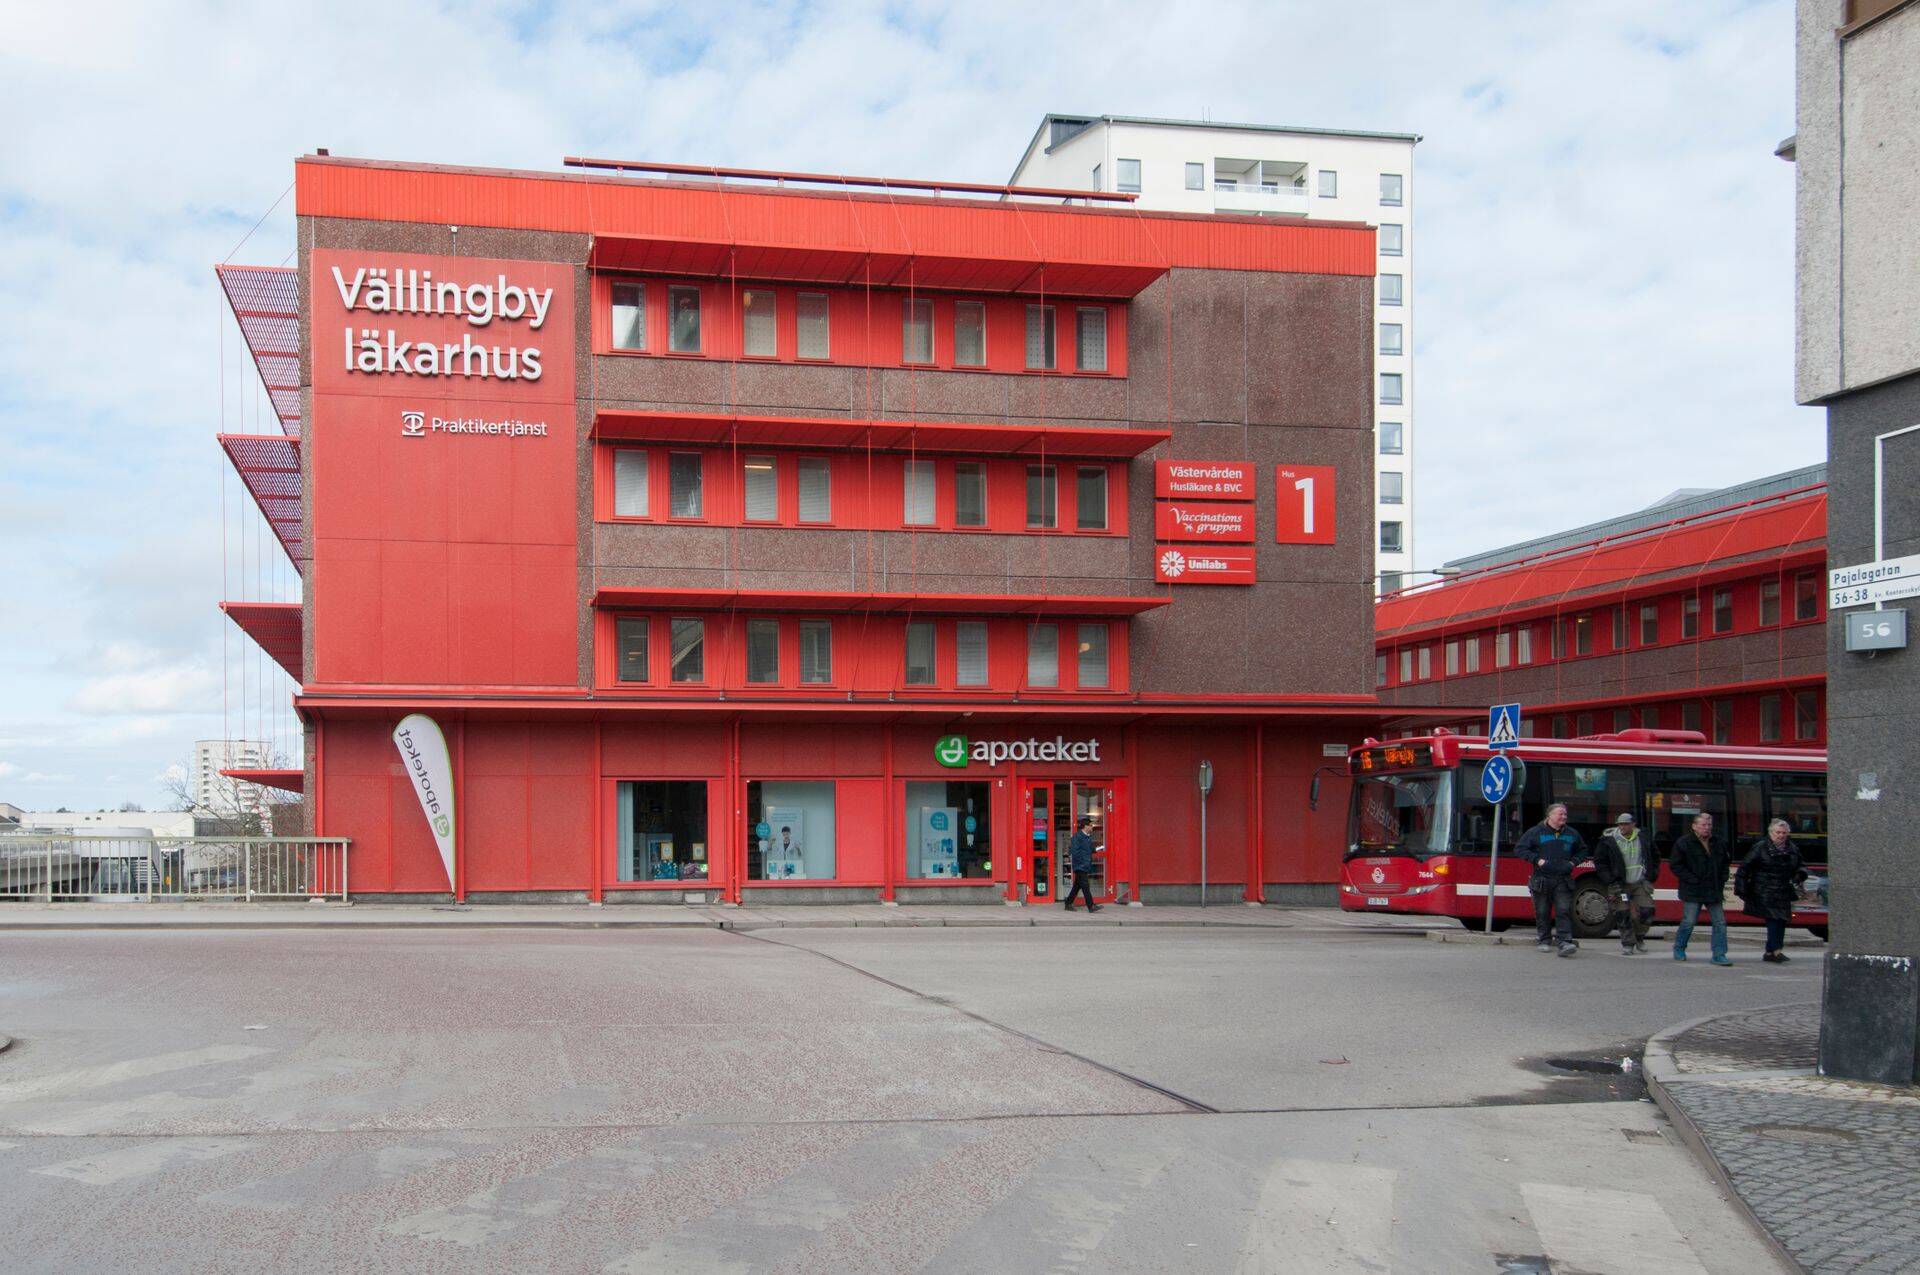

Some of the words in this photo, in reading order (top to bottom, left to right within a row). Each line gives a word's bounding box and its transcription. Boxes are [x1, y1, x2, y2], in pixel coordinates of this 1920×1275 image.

[332, 266, 553, 329] Vällingby
[345, 327, 542, 380] läkarhus
[432, 417, 547, 437] Praktikertjänst
[1170, 466, 1243, 478] Västervården
[1281, 470, 1295, 478] Hus
[1170, 482, 1213, 492] Husläkare
[1214, 483, 1222, 491] &
[1223, 483, 1242, 493] BVC
[1295, 477, 1314, 534] 1
[1170, 507, 1243, 523] Vaccinations
[1196, 521, 1241, 534] gruppen
[1188, 559, 1227, 570] Unilabs
[1834, 566, 1900, 585] Pajalagatan
[1835, 588, 1868, 605] 56-38
[1862, 622, 1891, 638] 56
[972, 735, 1101, 767] apoteket
